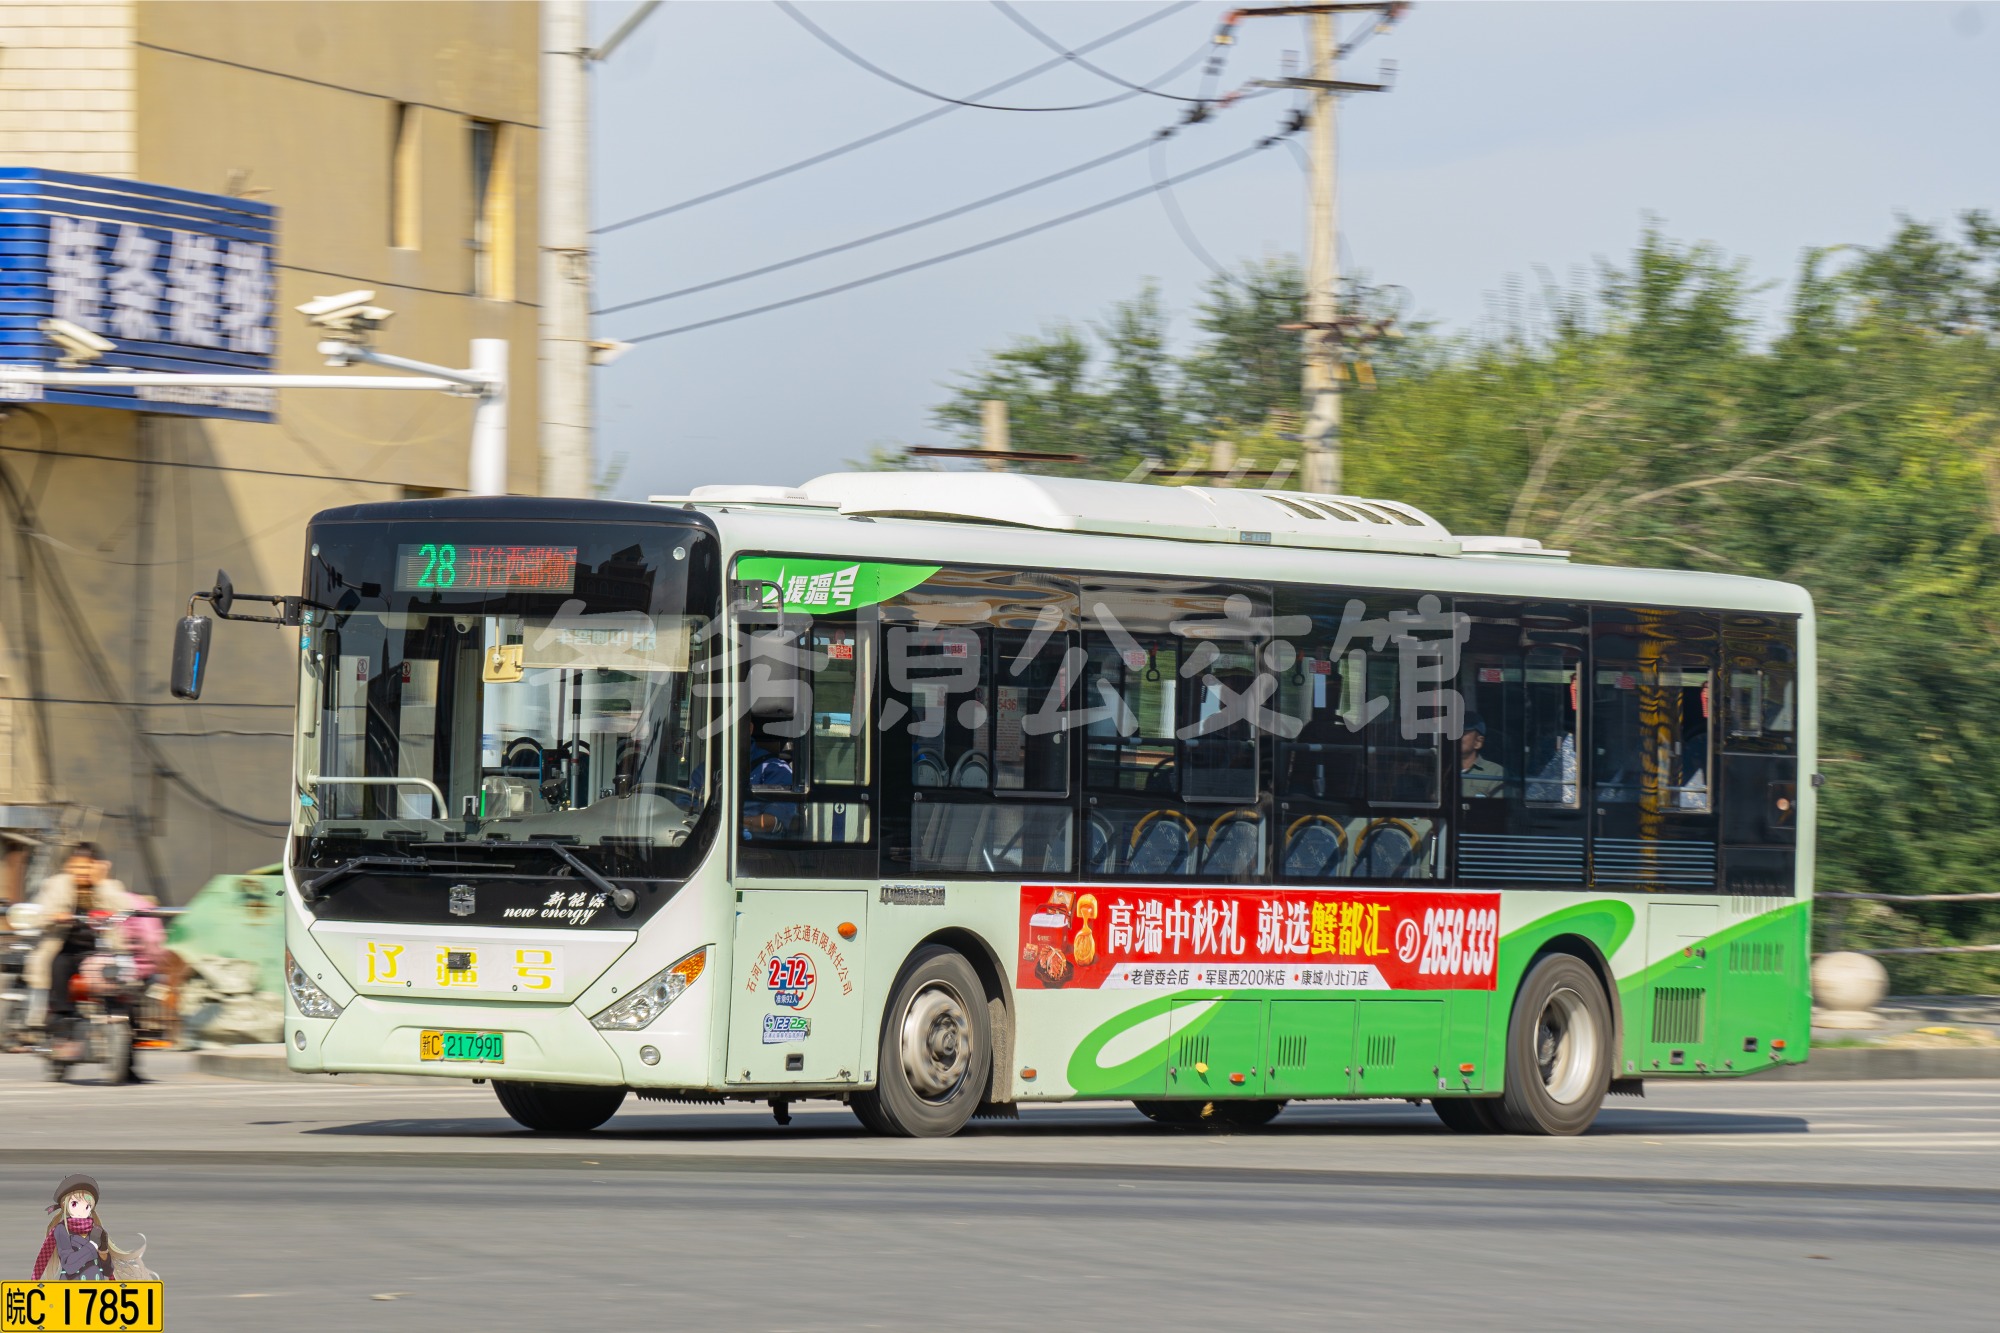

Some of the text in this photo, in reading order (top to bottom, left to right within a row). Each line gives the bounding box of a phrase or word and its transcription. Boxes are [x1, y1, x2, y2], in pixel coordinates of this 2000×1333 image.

[418, 544, 456, 588] 28
[544, 891, 608, 908] 新能源
[503, 907, 598, 925] new energy
[1108, 898, 1246, 955] 高端中秋礼
[1256, 899, 1391, 957] 就选蟹都汇
[746, 924, 853, 996] 石河子市公共交通有限责任公司
[768, 957, 807, 987] 2-72
[1131, 969, 1369, 986] 老管委会店 军垦西200米店 康城小北门店
